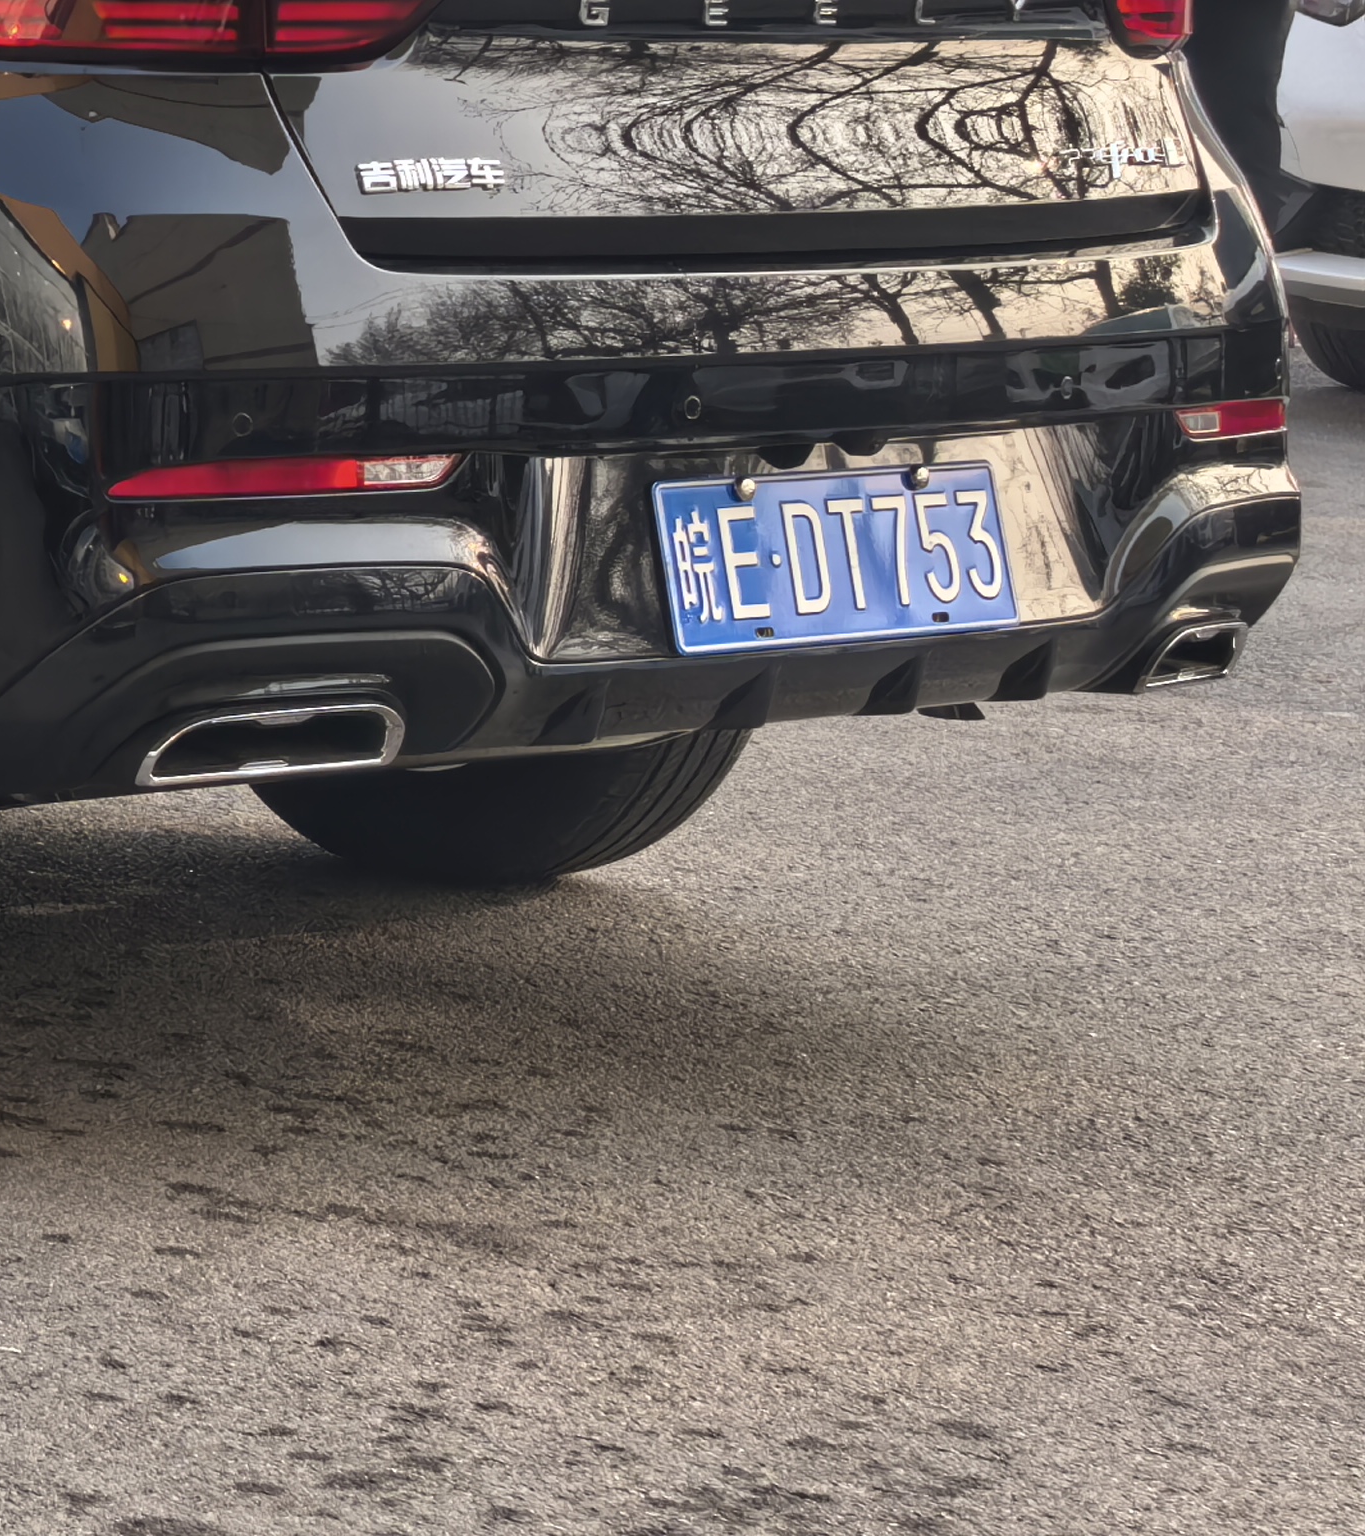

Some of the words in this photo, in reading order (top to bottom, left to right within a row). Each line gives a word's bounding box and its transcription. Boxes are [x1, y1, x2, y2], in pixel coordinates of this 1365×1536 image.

[356, 157, 505, 193] 吉利汽车
[672, 490, 1002, 622] 皖E·DT753
